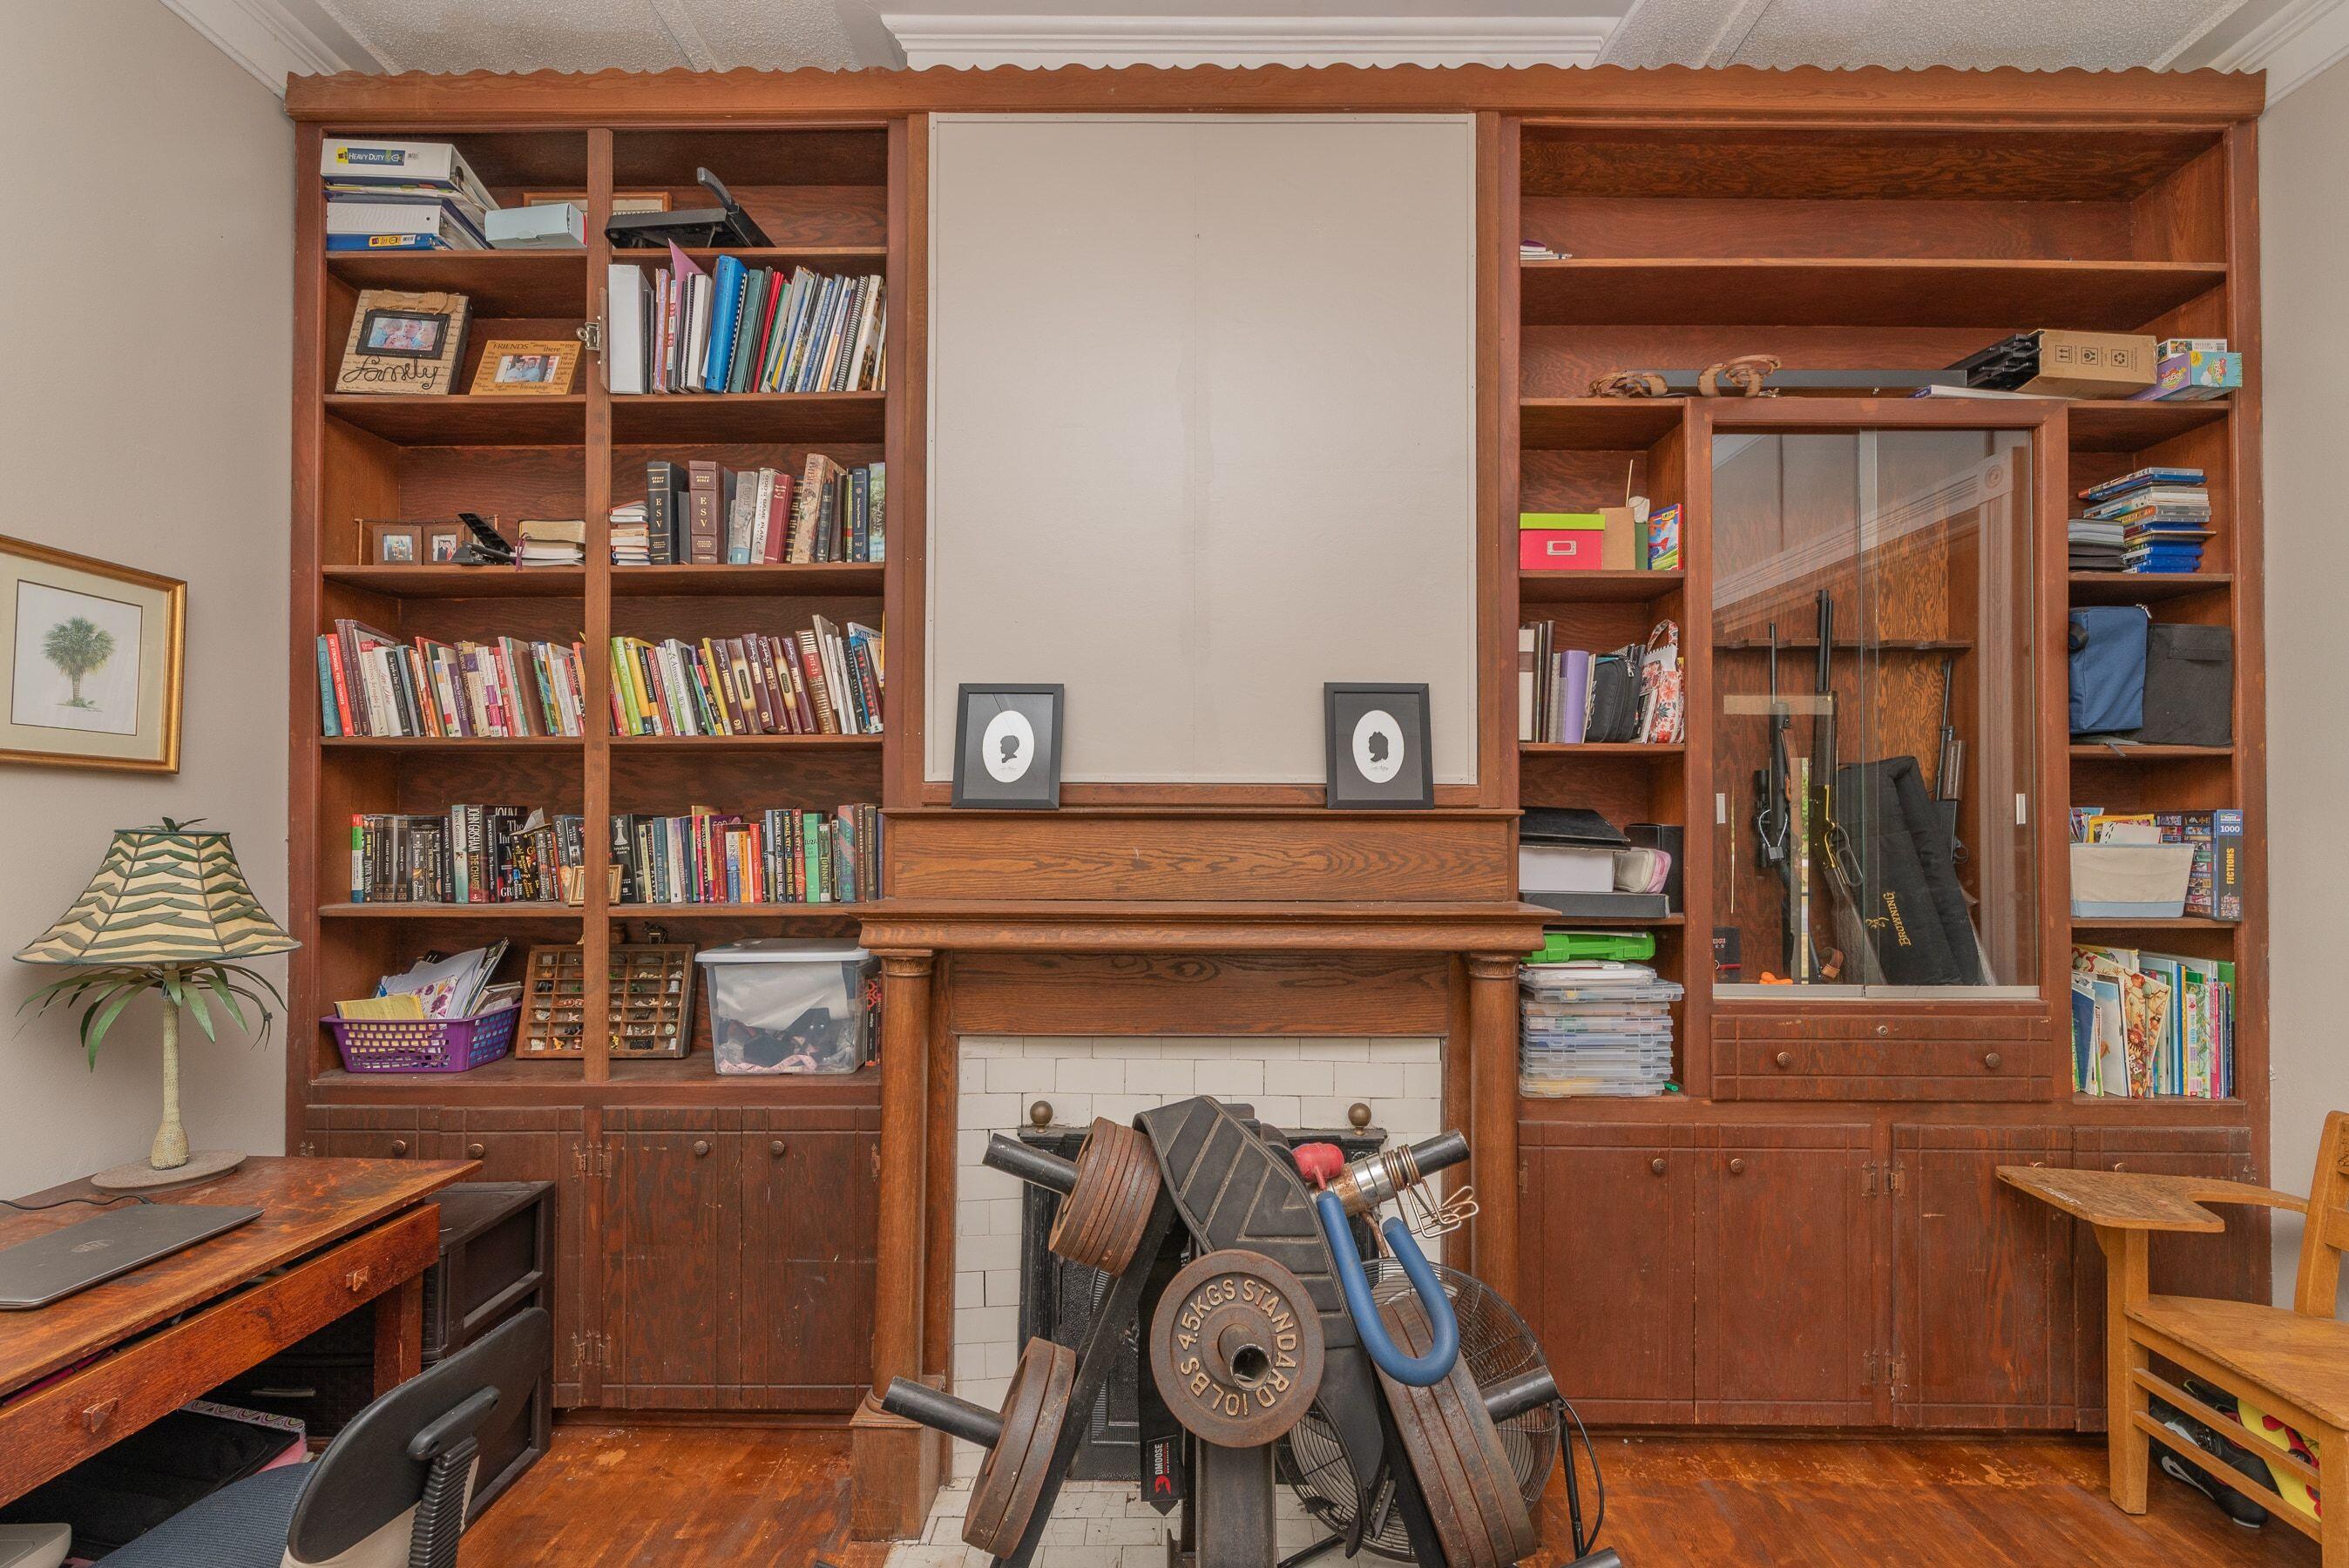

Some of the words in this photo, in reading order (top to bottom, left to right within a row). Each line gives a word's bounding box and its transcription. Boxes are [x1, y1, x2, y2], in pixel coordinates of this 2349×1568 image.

[342, 355, 437, 389] family
[389, 662, 397, 673] Apple
[670, 660, 683, 695] Answering
[467, 808, 480, 824] JOHN
[467, 824, 481, 852] GRISHAM
[364, 860, 373, 875] PAPER
[470, 855, 479, 866] THE
[2226, 848, 2235, 885] FICTIONS
[470, 866, 479, 890] CHAMBER
[1883, 891, 1912, 947] BROWNING
[1242, 1279, 1296, 1408] STANDARD
[1154, 1443, 1163, 1476] DMOOSE
